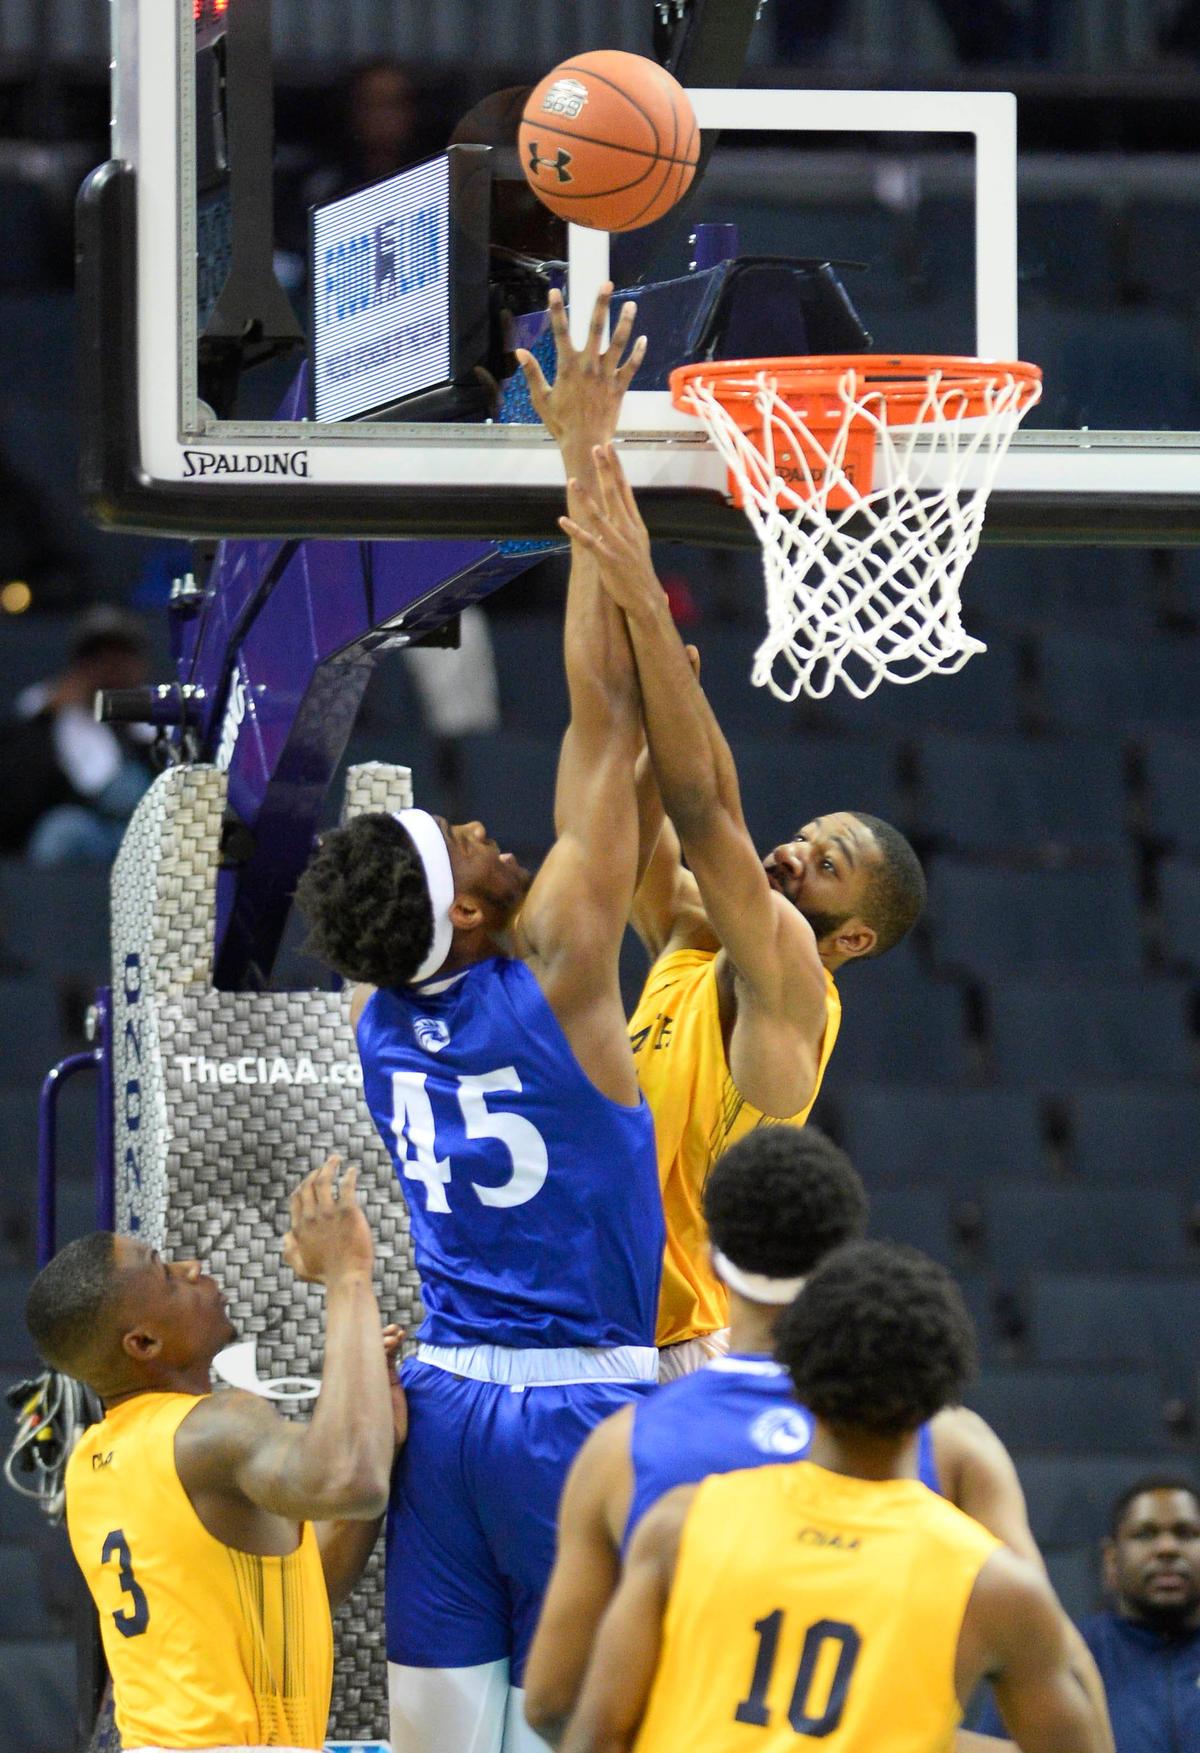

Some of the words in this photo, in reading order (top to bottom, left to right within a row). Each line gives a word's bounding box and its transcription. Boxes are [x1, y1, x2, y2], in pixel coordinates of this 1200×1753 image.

[183, 450, 308, 478] SPALDING
[391, 1065, 549, 1214] 45
[101, 1529, 150, 1638] 3
[735, 1607, 863, 1739] 10
